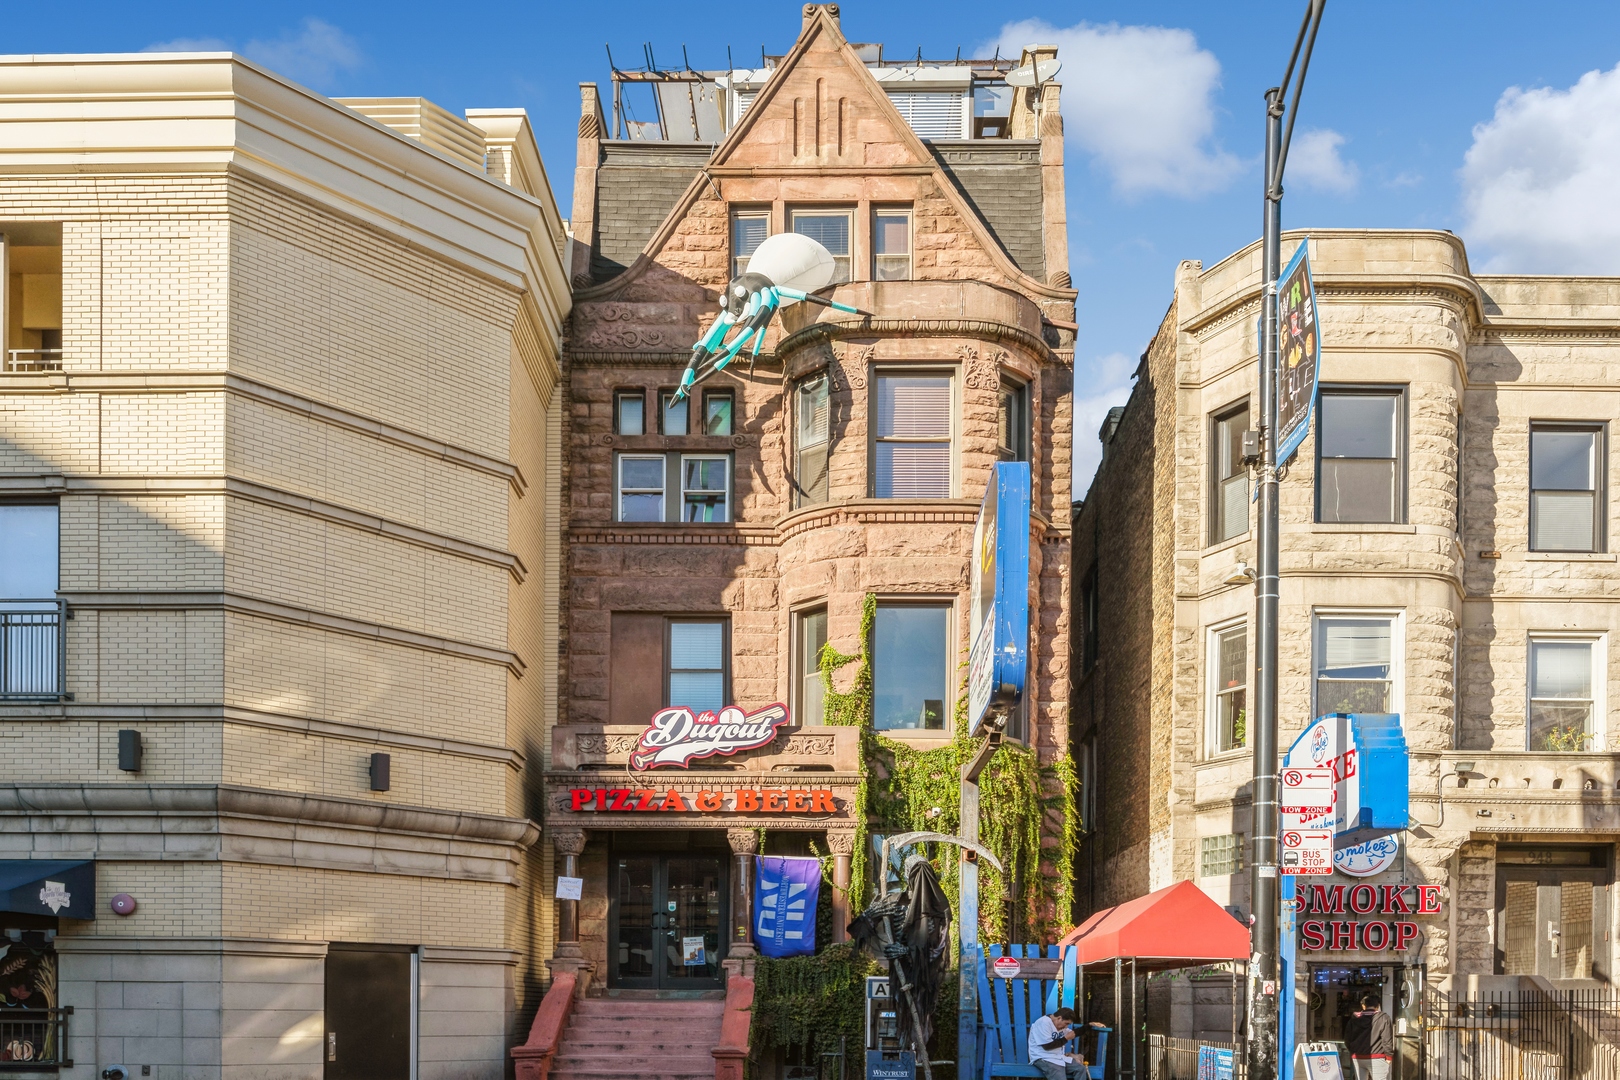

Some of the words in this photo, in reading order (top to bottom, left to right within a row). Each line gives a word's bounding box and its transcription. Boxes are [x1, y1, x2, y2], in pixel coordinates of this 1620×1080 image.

[698, 712, 716, 723] the
[642, 708, 773, 747] Dugout
[569, 788, 688, 812] PIZZA
[695, 789, 724, 812] &
[735, 789, 837, 813] BEER
[1302, 850, 1321, 858] BUS
[1302, 859, 1325, 867] STOP
[1302, 920, 1419, 951] SHOP
